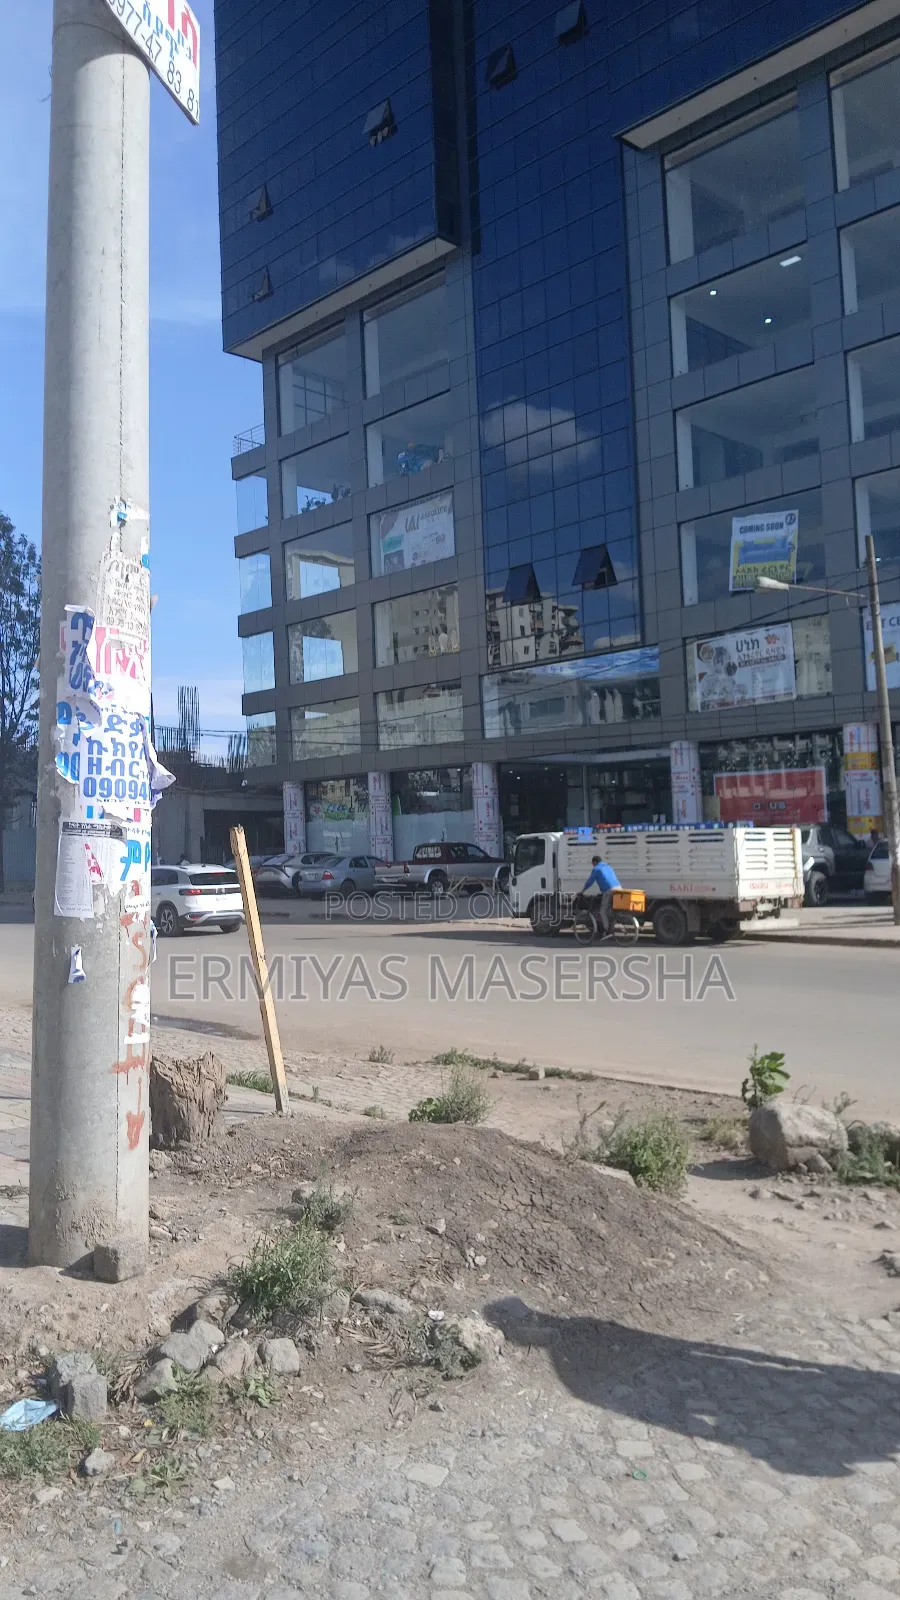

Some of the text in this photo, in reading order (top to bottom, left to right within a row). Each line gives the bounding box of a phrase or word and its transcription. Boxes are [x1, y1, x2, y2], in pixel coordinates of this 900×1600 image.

[108, 0, 162, 63] 977-47
[739, 521, 785, 535] COMING SOON
[83, 776, 152, 801] 09094
